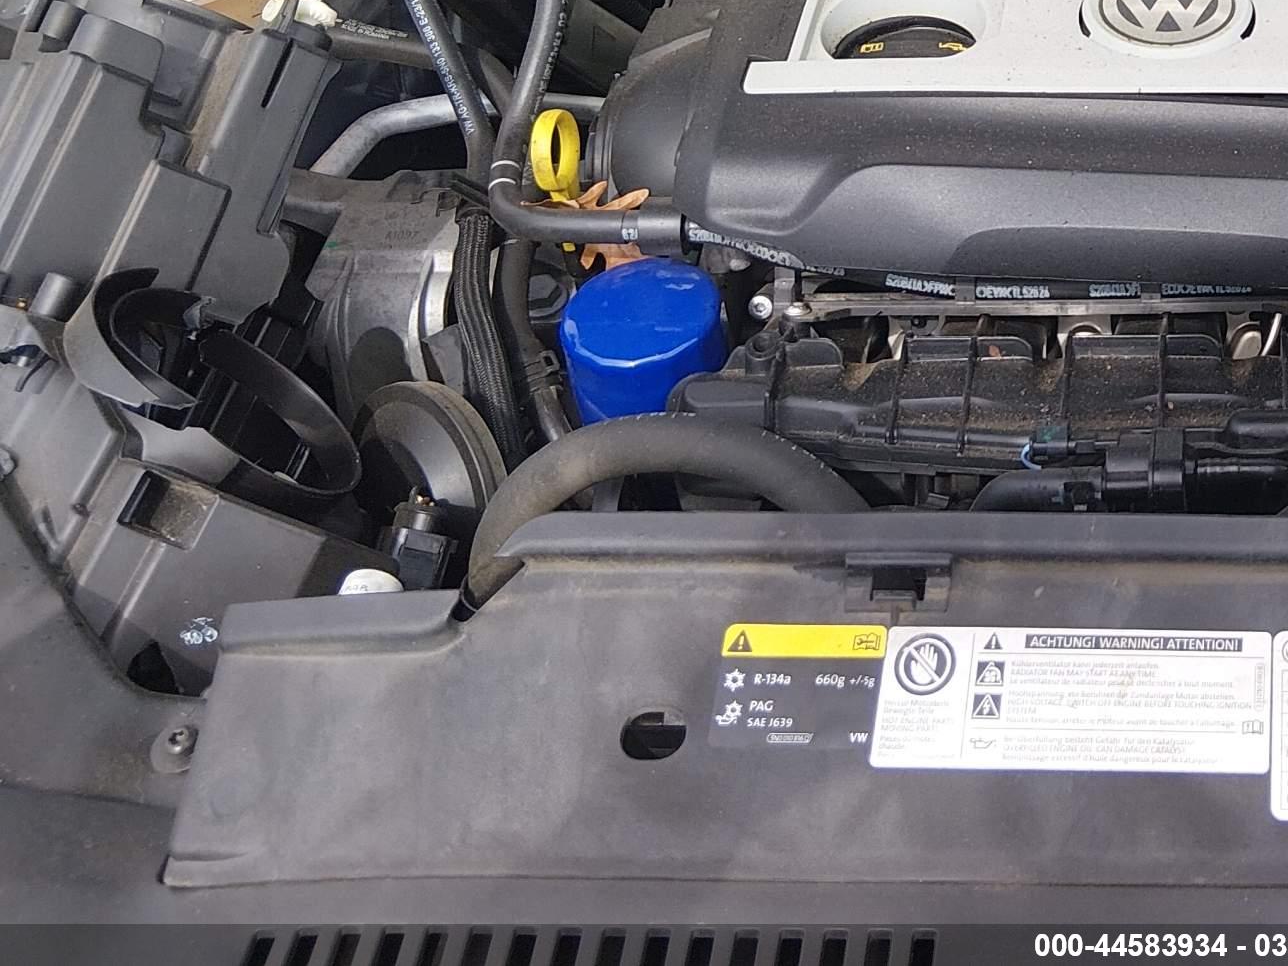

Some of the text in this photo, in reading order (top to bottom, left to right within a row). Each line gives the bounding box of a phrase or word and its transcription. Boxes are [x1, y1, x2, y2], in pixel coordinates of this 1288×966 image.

[1029, 635, 1239, 651] ACHTUNG! WARNING! ATTENTION!
[753, 674, 792, 684] R-134a
[815, 674, 846, 688] 660g
[749, 700, 774, 712] PAG
[747, 717, 793, 728] SAE J639
[849, 732, 869, 744] VW
